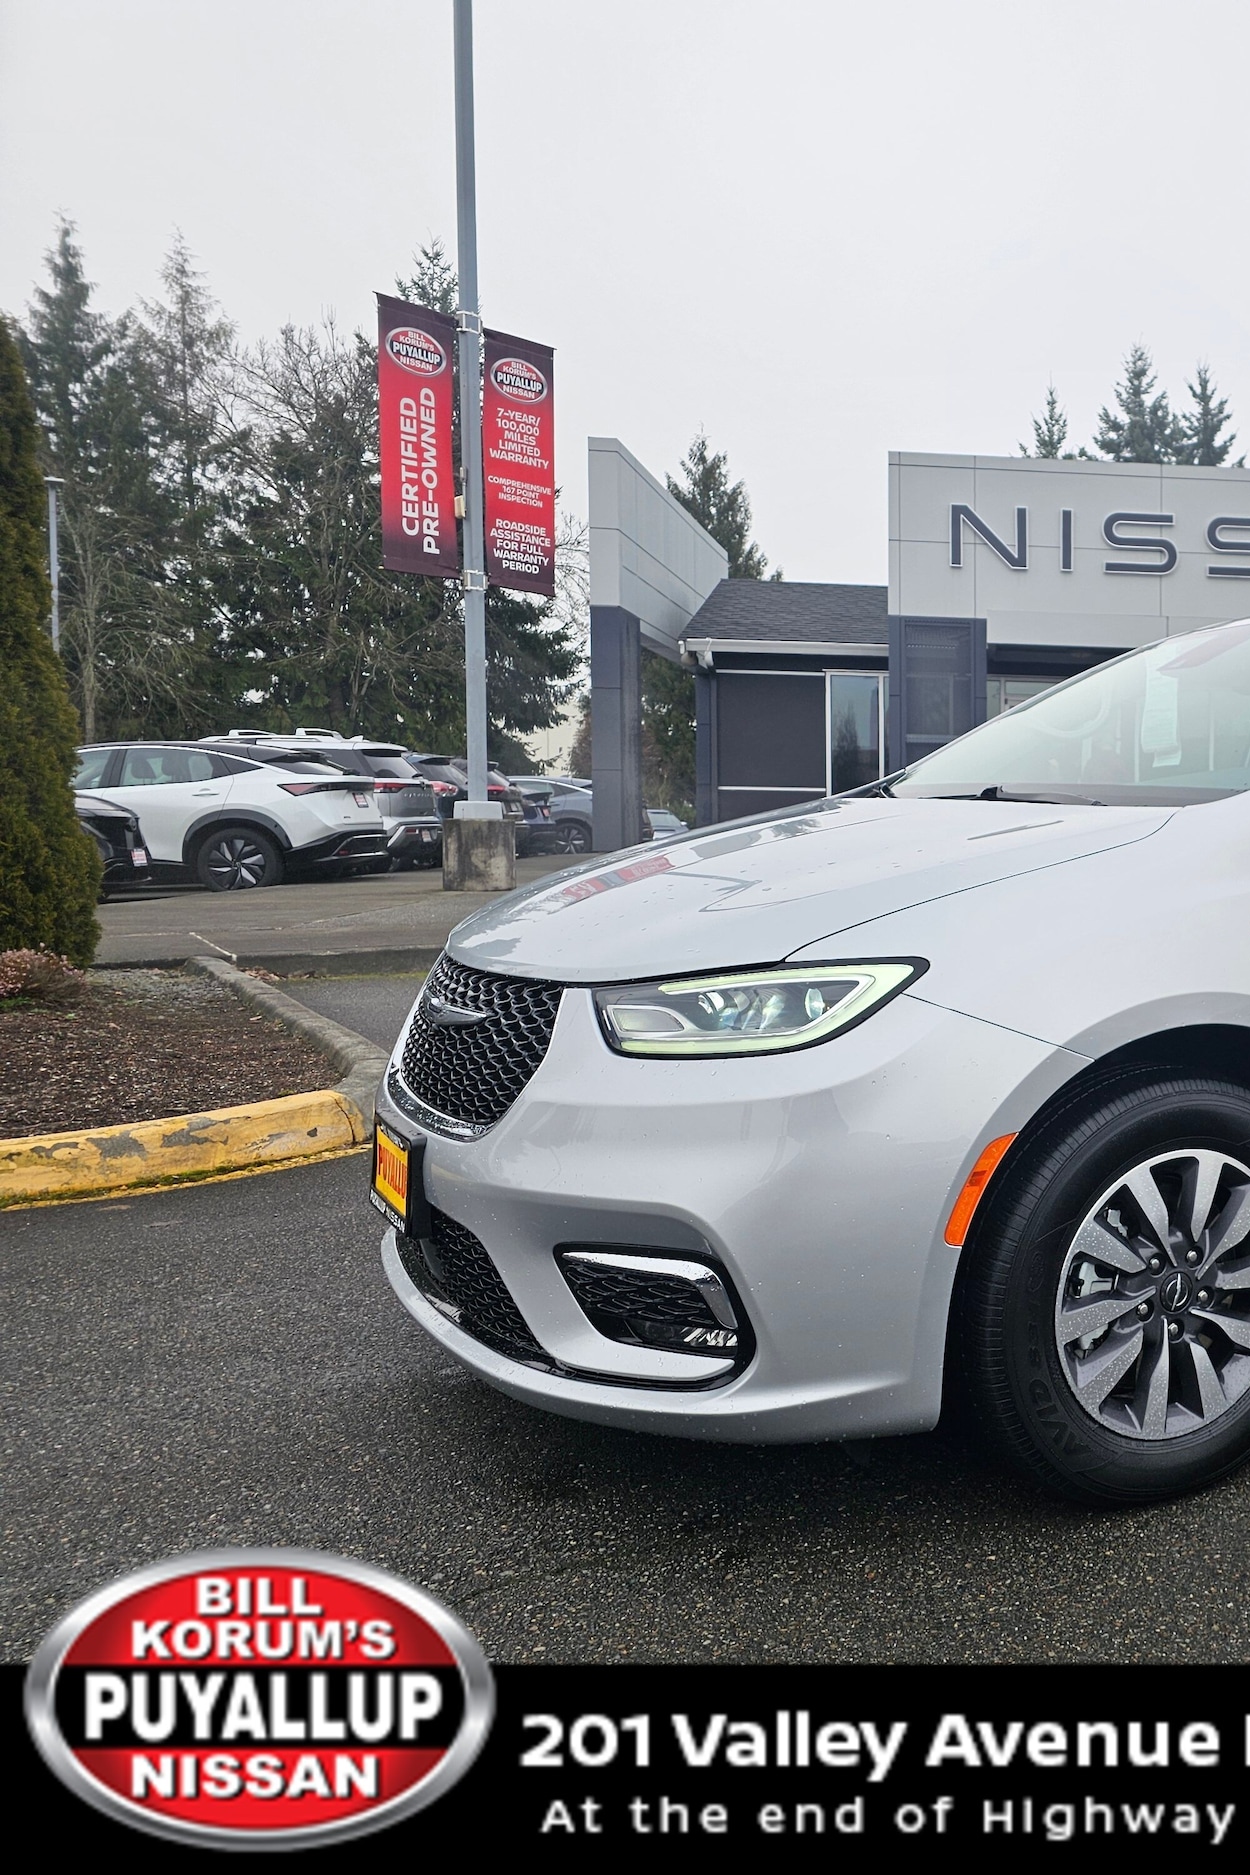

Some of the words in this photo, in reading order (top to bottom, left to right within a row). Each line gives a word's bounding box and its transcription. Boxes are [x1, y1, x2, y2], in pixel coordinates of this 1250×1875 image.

[399, 335, 435, 352] KORUM'S
[407, 331, 426, 341] BILL
[392, 341, 441, 365] PUYALLUP
[400, 356, 433, 372] NISSAN
[502, 365, 537, 380] KORUM'S
[511, 361, 528, 371] BILL
[497, 371, 542, 392] PUYALLUP
[503, 385, 535, 399] NISSAN
[496, 407, 541, 427] 7-YEAR/
[496, 418, 540, 436] 100,000
[504, 431, 537, 446] MILES
[498, 439, 541, 457] LIMITED
[400, 397, 420, 536] CERTIFIED
[489, 448, 549, 470] WARRANTY
[419, 387, 440, 554] PRE-OWNED
[487, 475, 552, 496] COMPREHENSIVE
[502, 485, 515, 494] 167
[516, 488, 540, 500] POINT
[498, 492, 543, 509] INSPECTION
[495, 518, 547, 537] ROADSIDE
[490, 528, 551, 548] ASSISTANCE
[496, 538, 519, 552] FOR
[520, 543, 544, 556] FULL
[493, 548, 549, 567] WARRANTY
[502, 559, 540, 575] PERIOD
[378, 1143, 407, 1200] PUYALLU
